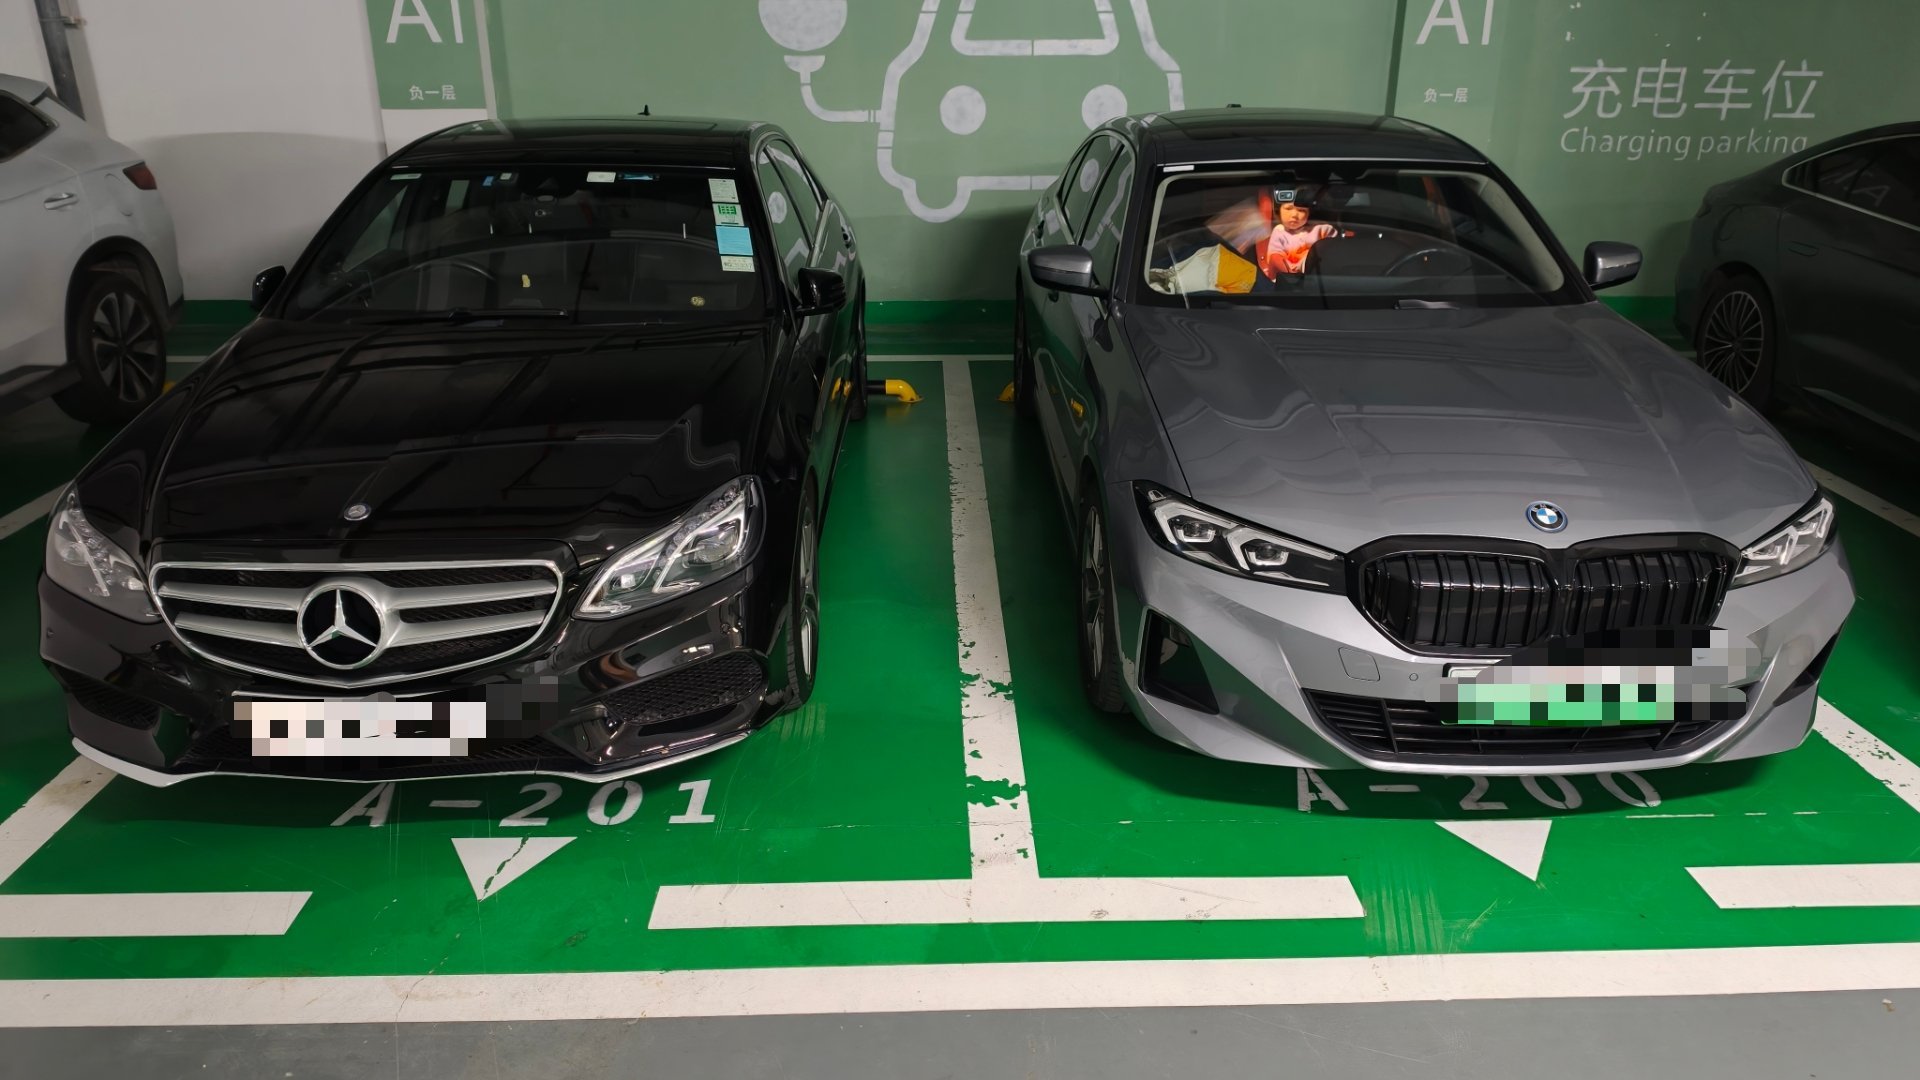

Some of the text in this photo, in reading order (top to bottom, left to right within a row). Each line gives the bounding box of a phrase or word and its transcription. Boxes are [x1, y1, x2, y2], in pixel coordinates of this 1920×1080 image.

[409, 84, 456, 101] 负一层
[1423, 87, 1468, 103] 负一层
[1563, 58, 1824, 121] 充电车位
[1560, 126, 1691, 161] Charging
[330, 779, 716, 827] A-201
